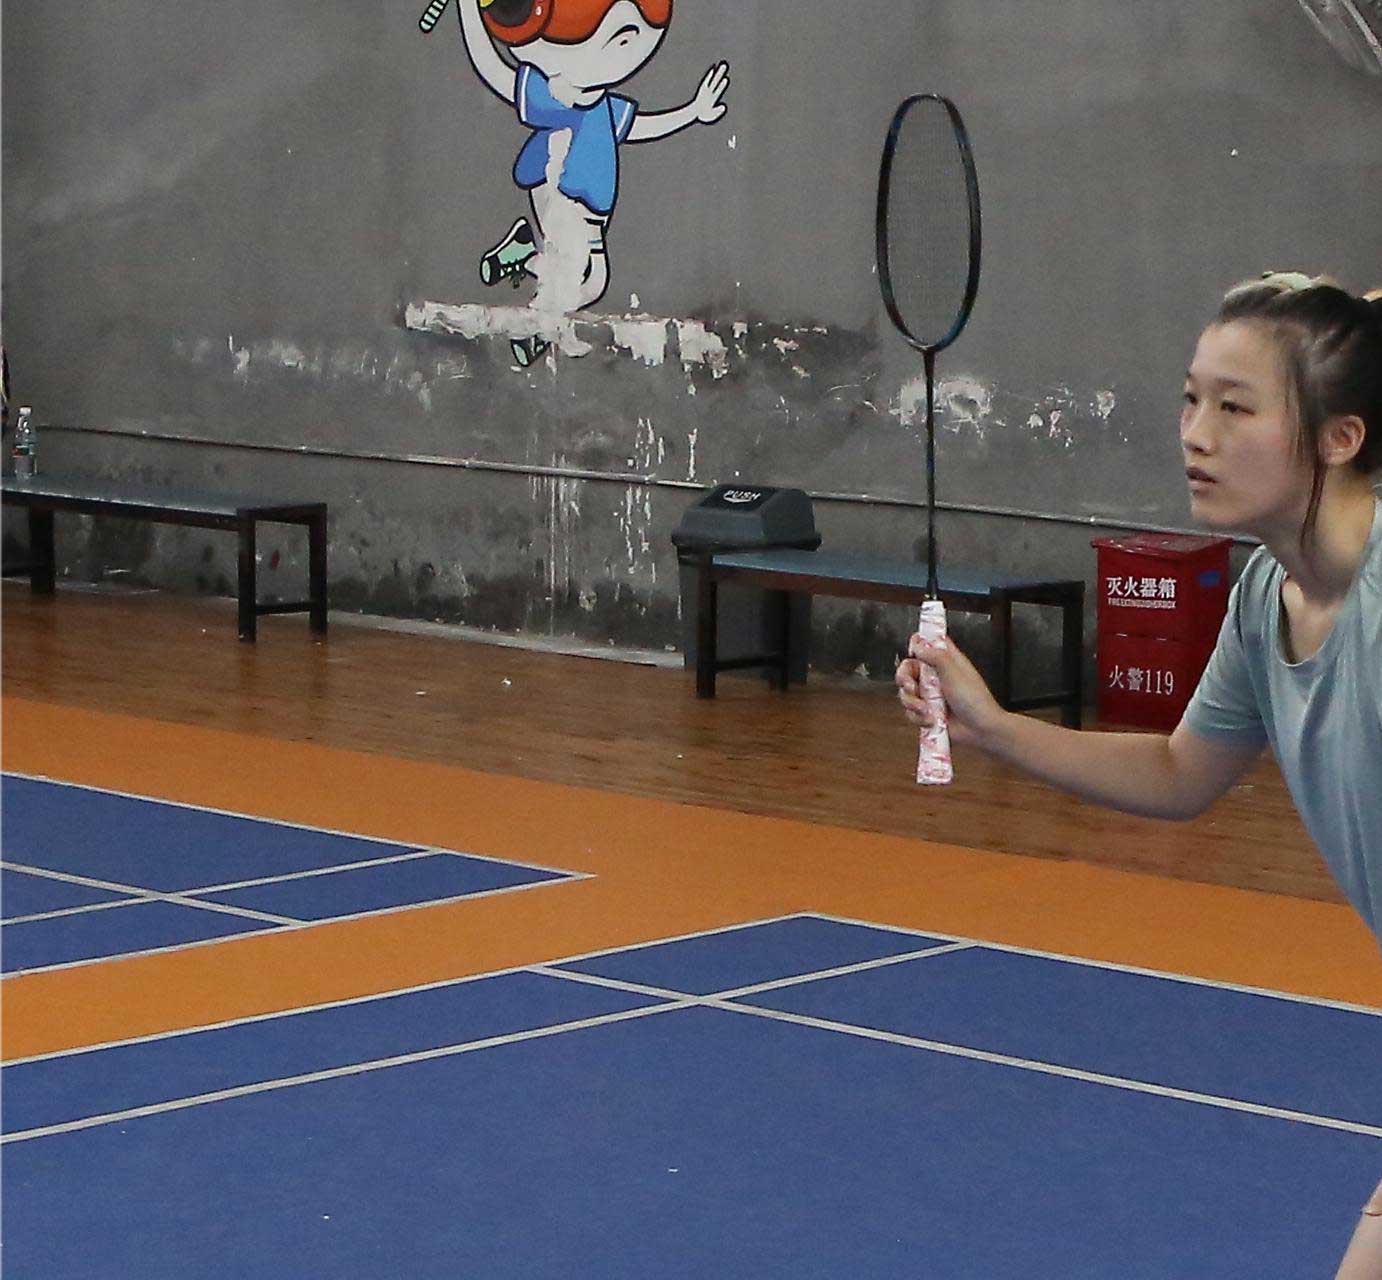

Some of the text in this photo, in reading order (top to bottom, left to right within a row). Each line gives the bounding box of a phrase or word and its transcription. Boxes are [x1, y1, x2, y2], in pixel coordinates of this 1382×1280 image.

[725, 489, 761, 501] PUSH
[1105, 576, 1177, 599] 灭火器箱
